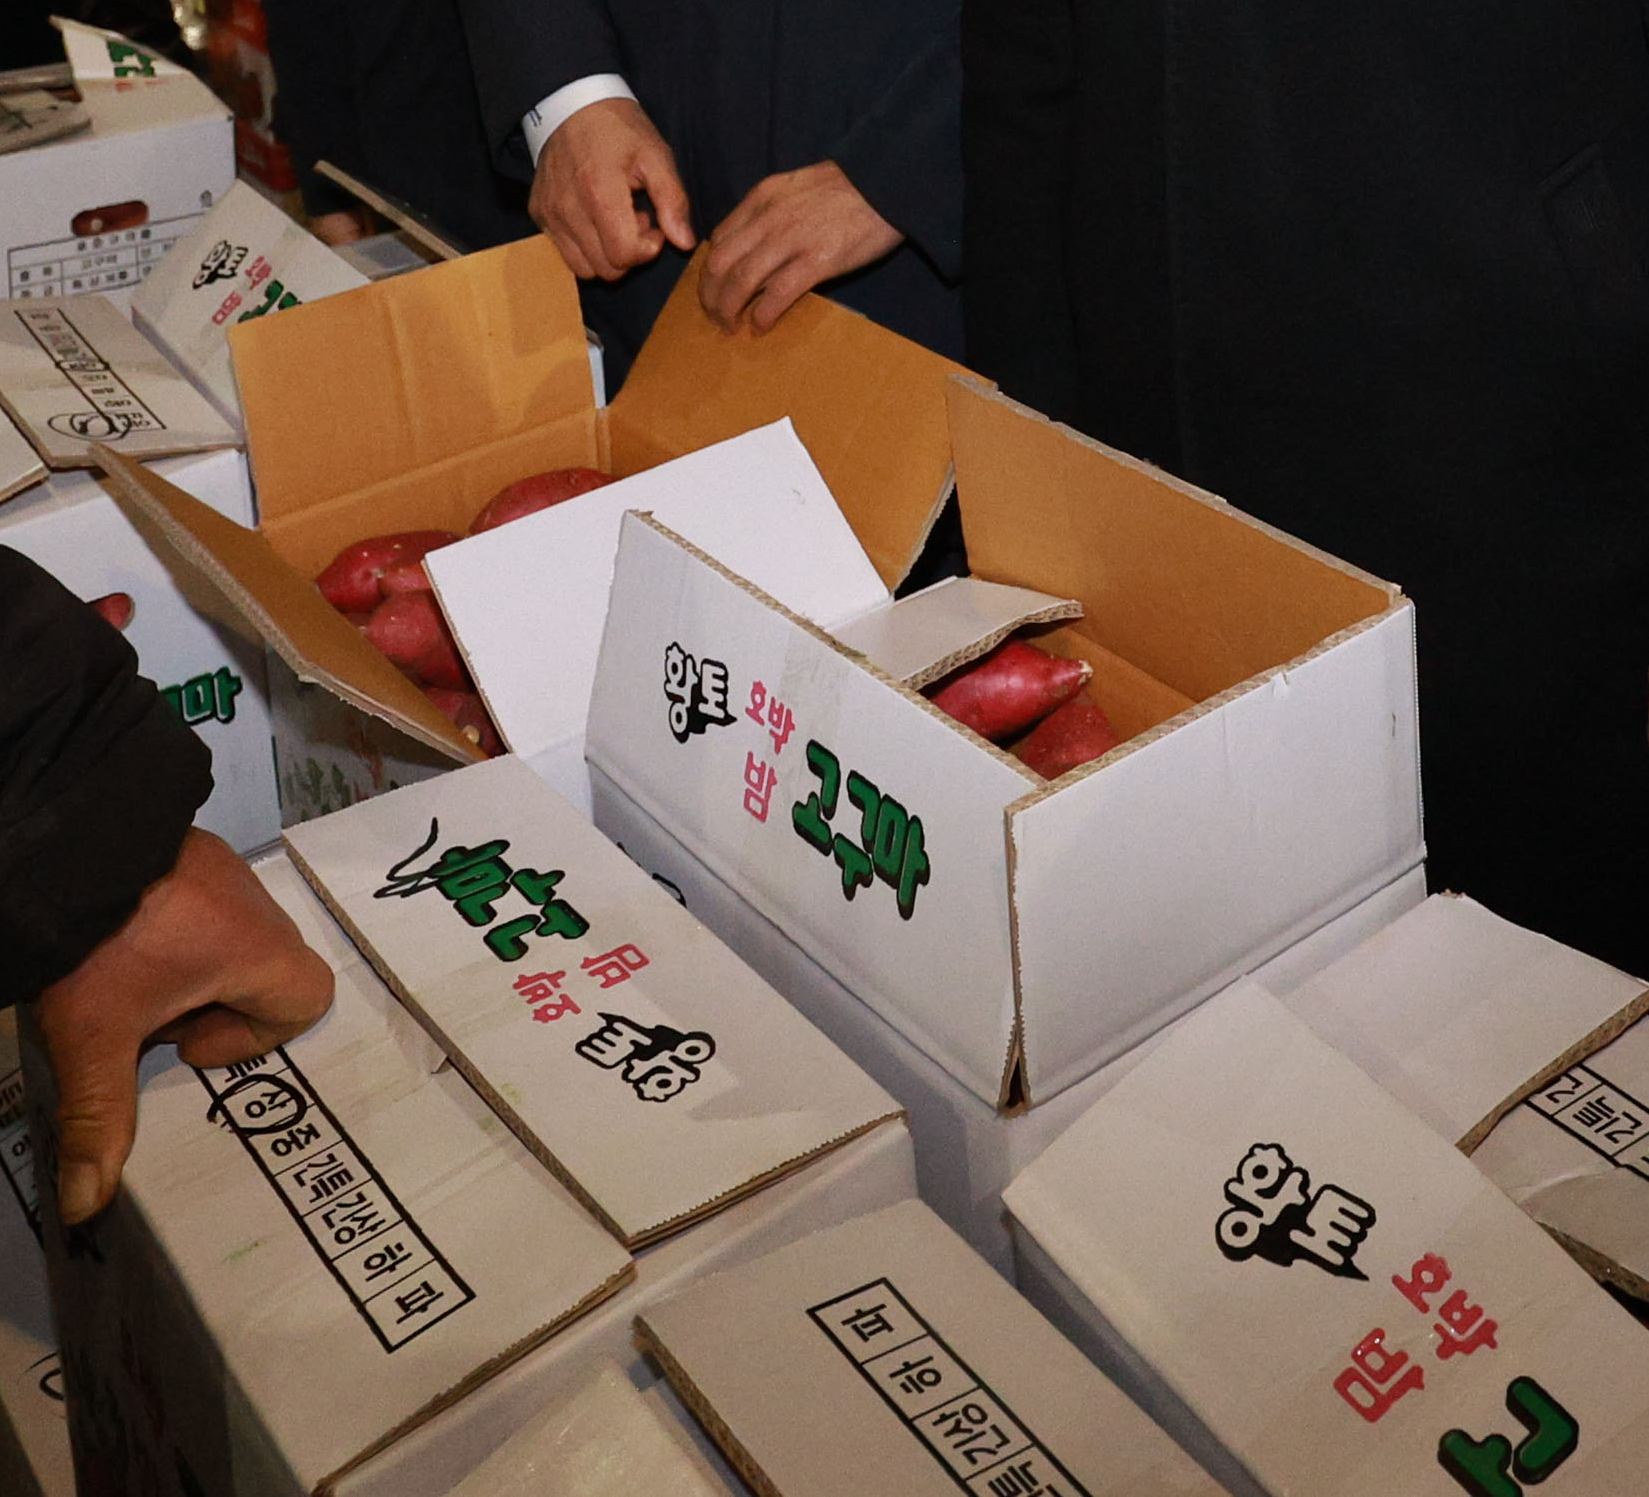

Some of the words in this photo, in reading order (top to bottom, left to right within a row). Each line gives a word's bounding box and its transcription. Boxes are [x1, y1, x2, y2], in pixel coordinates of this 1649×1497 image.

[664, 641, 737, 743] 황토
[744, 680, 796, 757] 호박
[743, 751, 778, 823] 밤
[792, 740, 930, 920] 고구마
[431, 838, 591, 962] 고구마
[580, 942, 650, 991] 밤
[512, 970, 581, 1024] 호박
[574, 1011, 717, 1103] 황토
[244, 1090, 294, 1119] 상
[1572, 1095, 1643, 1144] 긴특
[271, 1123, 321, 1156] 중
[293, 1153, 354, 1203] 긴특
[321, 1191, 386, 1244] 긴상
[1215, 1143, 1376, 1281] 황토
[364, 1242, 413, 1282] 하
[395, 1280, 444, 1324] 파
[841, 1303, 895, 1343] 파
[1392, 1252, 1498, 1360] 호박
[888, 1355, 942, 1395] 하
[1333, 1328, 1426, 1424] 밤
[931, 1403, 1011, 1466] 긴상
